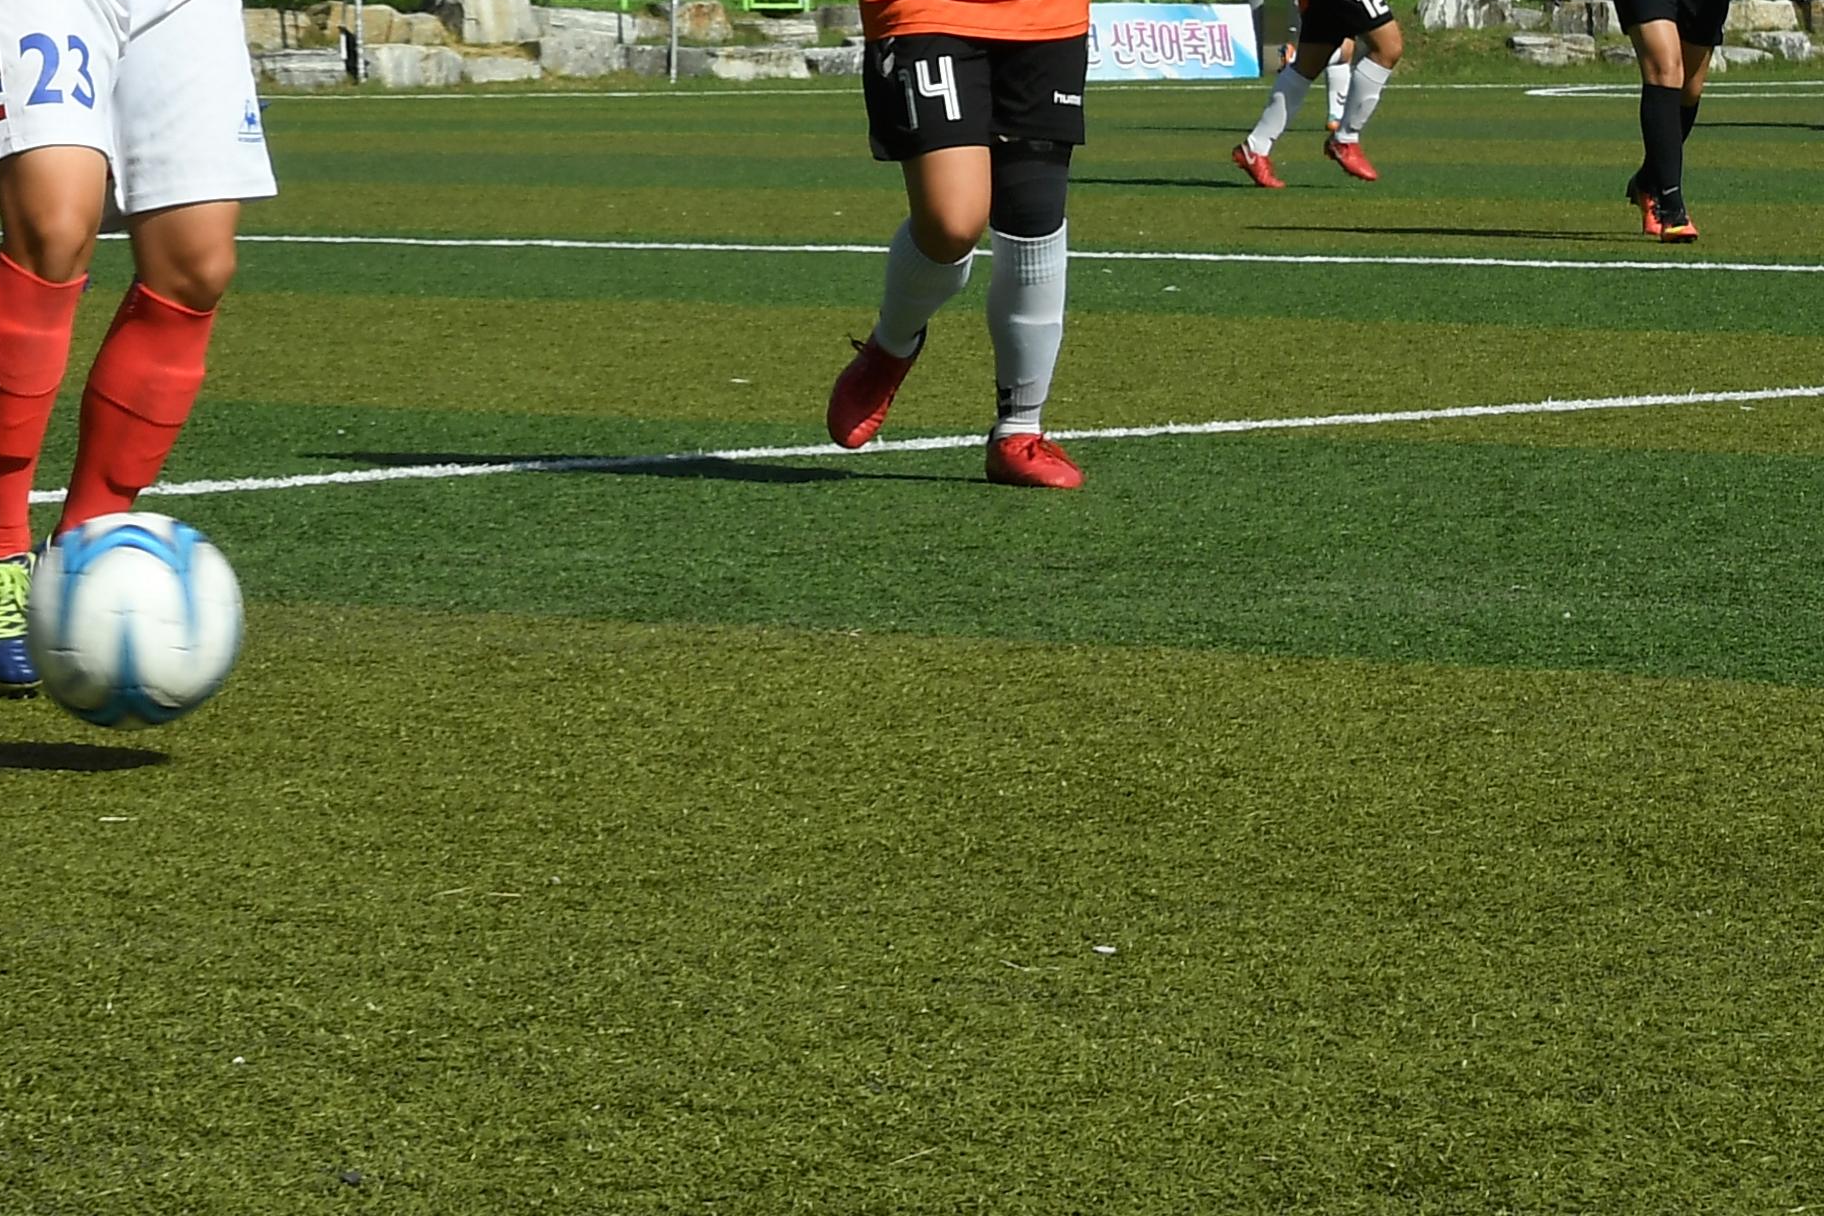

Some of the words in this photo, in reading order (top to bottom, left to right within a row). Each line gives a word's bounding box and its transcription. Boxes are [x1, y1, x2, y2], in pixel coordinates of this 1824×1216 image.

[19, 32, 96, 110] 23
[1111, 22, 1233, 66] 산천어축제
[897, 55, 962, 131] 14
